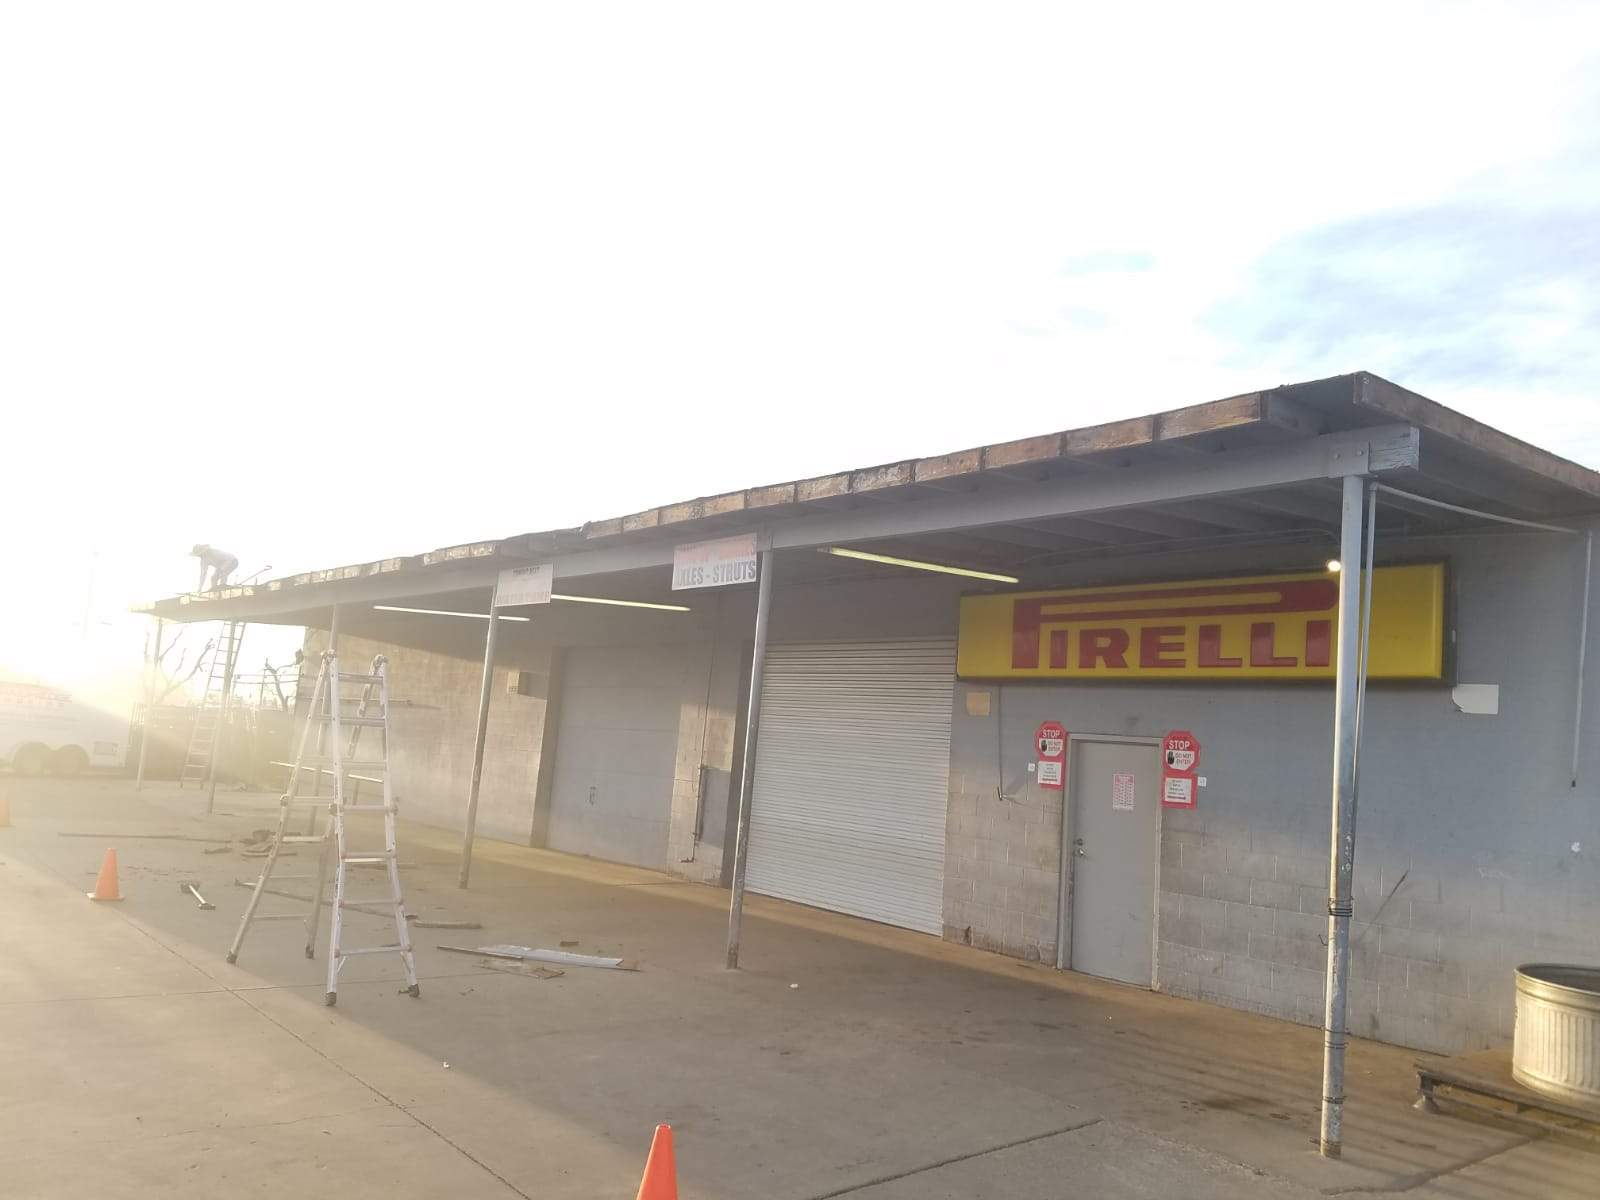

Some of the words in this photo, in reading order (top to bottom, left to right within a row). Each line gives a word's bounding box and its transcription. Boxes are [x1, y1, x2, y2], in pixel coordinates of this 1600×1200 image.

[712, 560, 757, 584] STRUTS
[1012, 578, 1339, 669] PIRELLI
[1042, 729, 1061, 738] STOP
[1168, 740, 1190, 750] STOP
